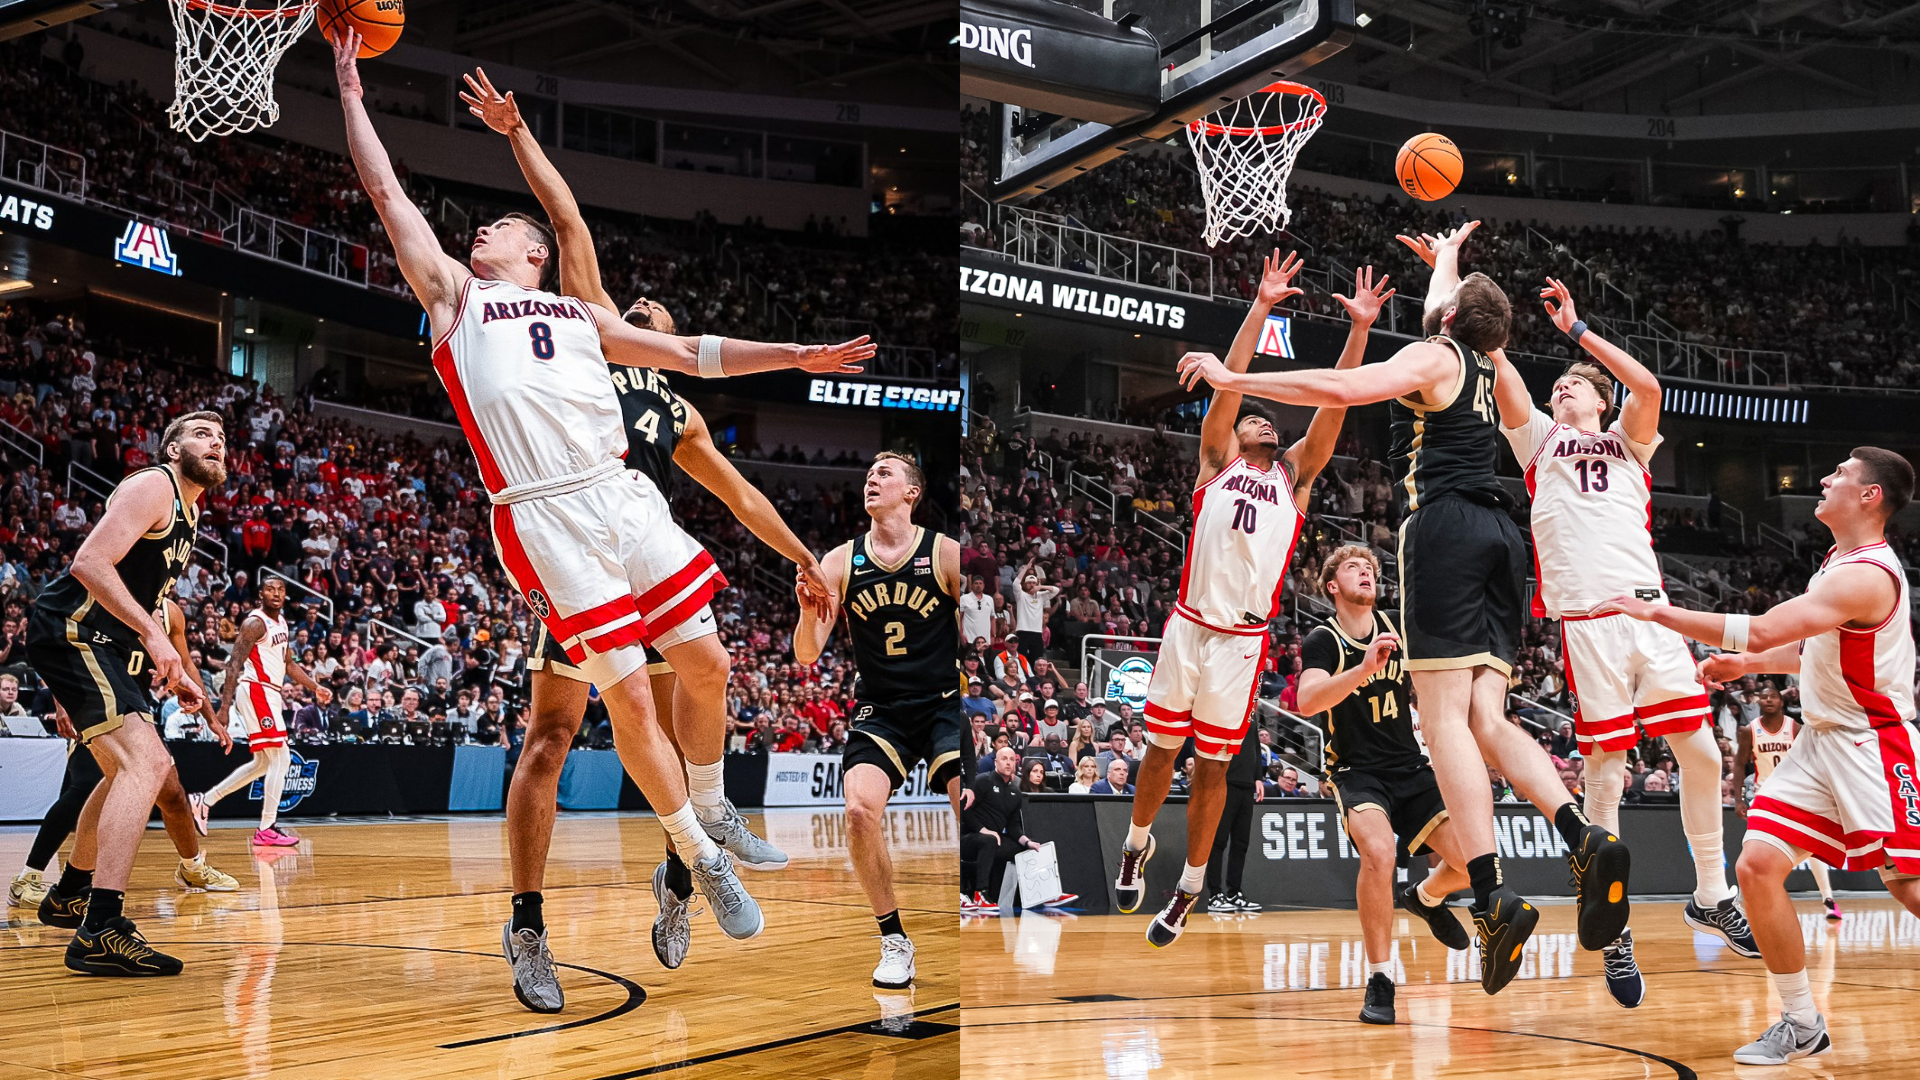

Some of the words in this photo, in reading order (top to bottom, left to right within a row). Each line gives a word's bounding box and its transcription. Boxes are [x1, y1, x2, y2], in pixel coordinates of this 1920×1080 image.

[960, 21, 1032, 68] DING
[535, 75, 558, 96] 218
[1318, 81, 1345, 103] 203
[836, 104, 860, 123] 219
[1647, 118, 1676, 138] 204
[0, 193, 54, 231] ATS
[482, 299, 587, 325] ARIZONA
[1052, 283, 1186, 330] WILDCATS
[529, 322, 555, 360] 8
[611, 366, 685, 436] PURDUE
[809, 379, 882, 407] ELITE
[882, 386, 960, 412] EIGHT
[1472, 373, 1495, 425] 45
[634, 408, 661, 444] 4
[1552, 438, 1629, 463] ARIZONA
[1221, 474, 1279, 507] ARIZONA
[1574, 459, 1609, 493] 13
[1231, 498, 1257, 535] 10
[851, 581, 940, 621] PURDUE
[884, 621, 908, 656] 2
[855, 705, 874, 721] P
[1368, 689, 1399, 724] 14
[800, 772, 809, 783] BY
[1893, 762, 1920, 826] CATS
[1261, 812, 1329, 860] SEE
[1494, 815, 1570, 858] NCAA
